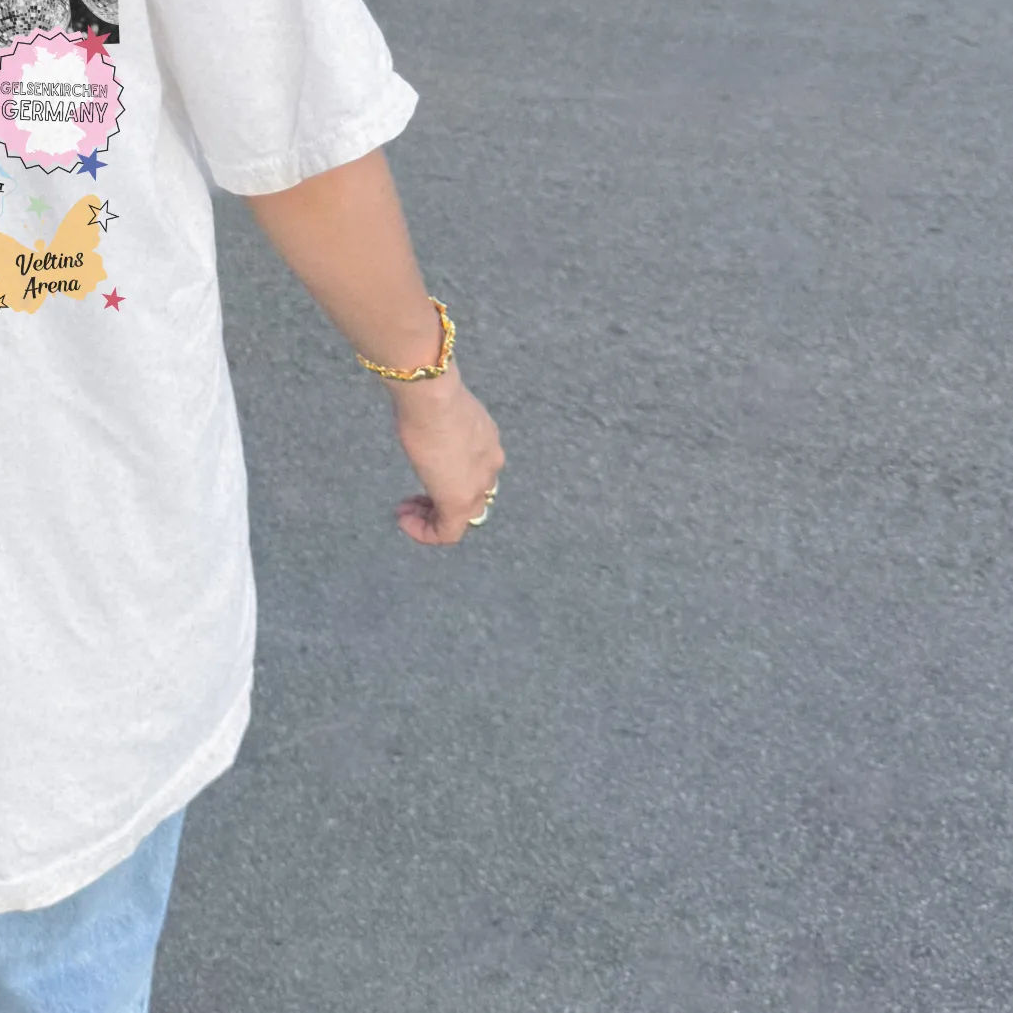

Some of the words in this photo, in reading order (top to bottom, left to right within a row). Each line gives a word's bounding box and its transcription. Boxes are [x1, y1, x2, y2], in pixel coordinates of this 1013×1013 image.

[0, 81, 108, 98] GELSENKIRCHEN
[1, 99, 109, 123] GERMANY
[15, 252, 84, 276] Veltins
[23, 275, 82, 300] Arena
